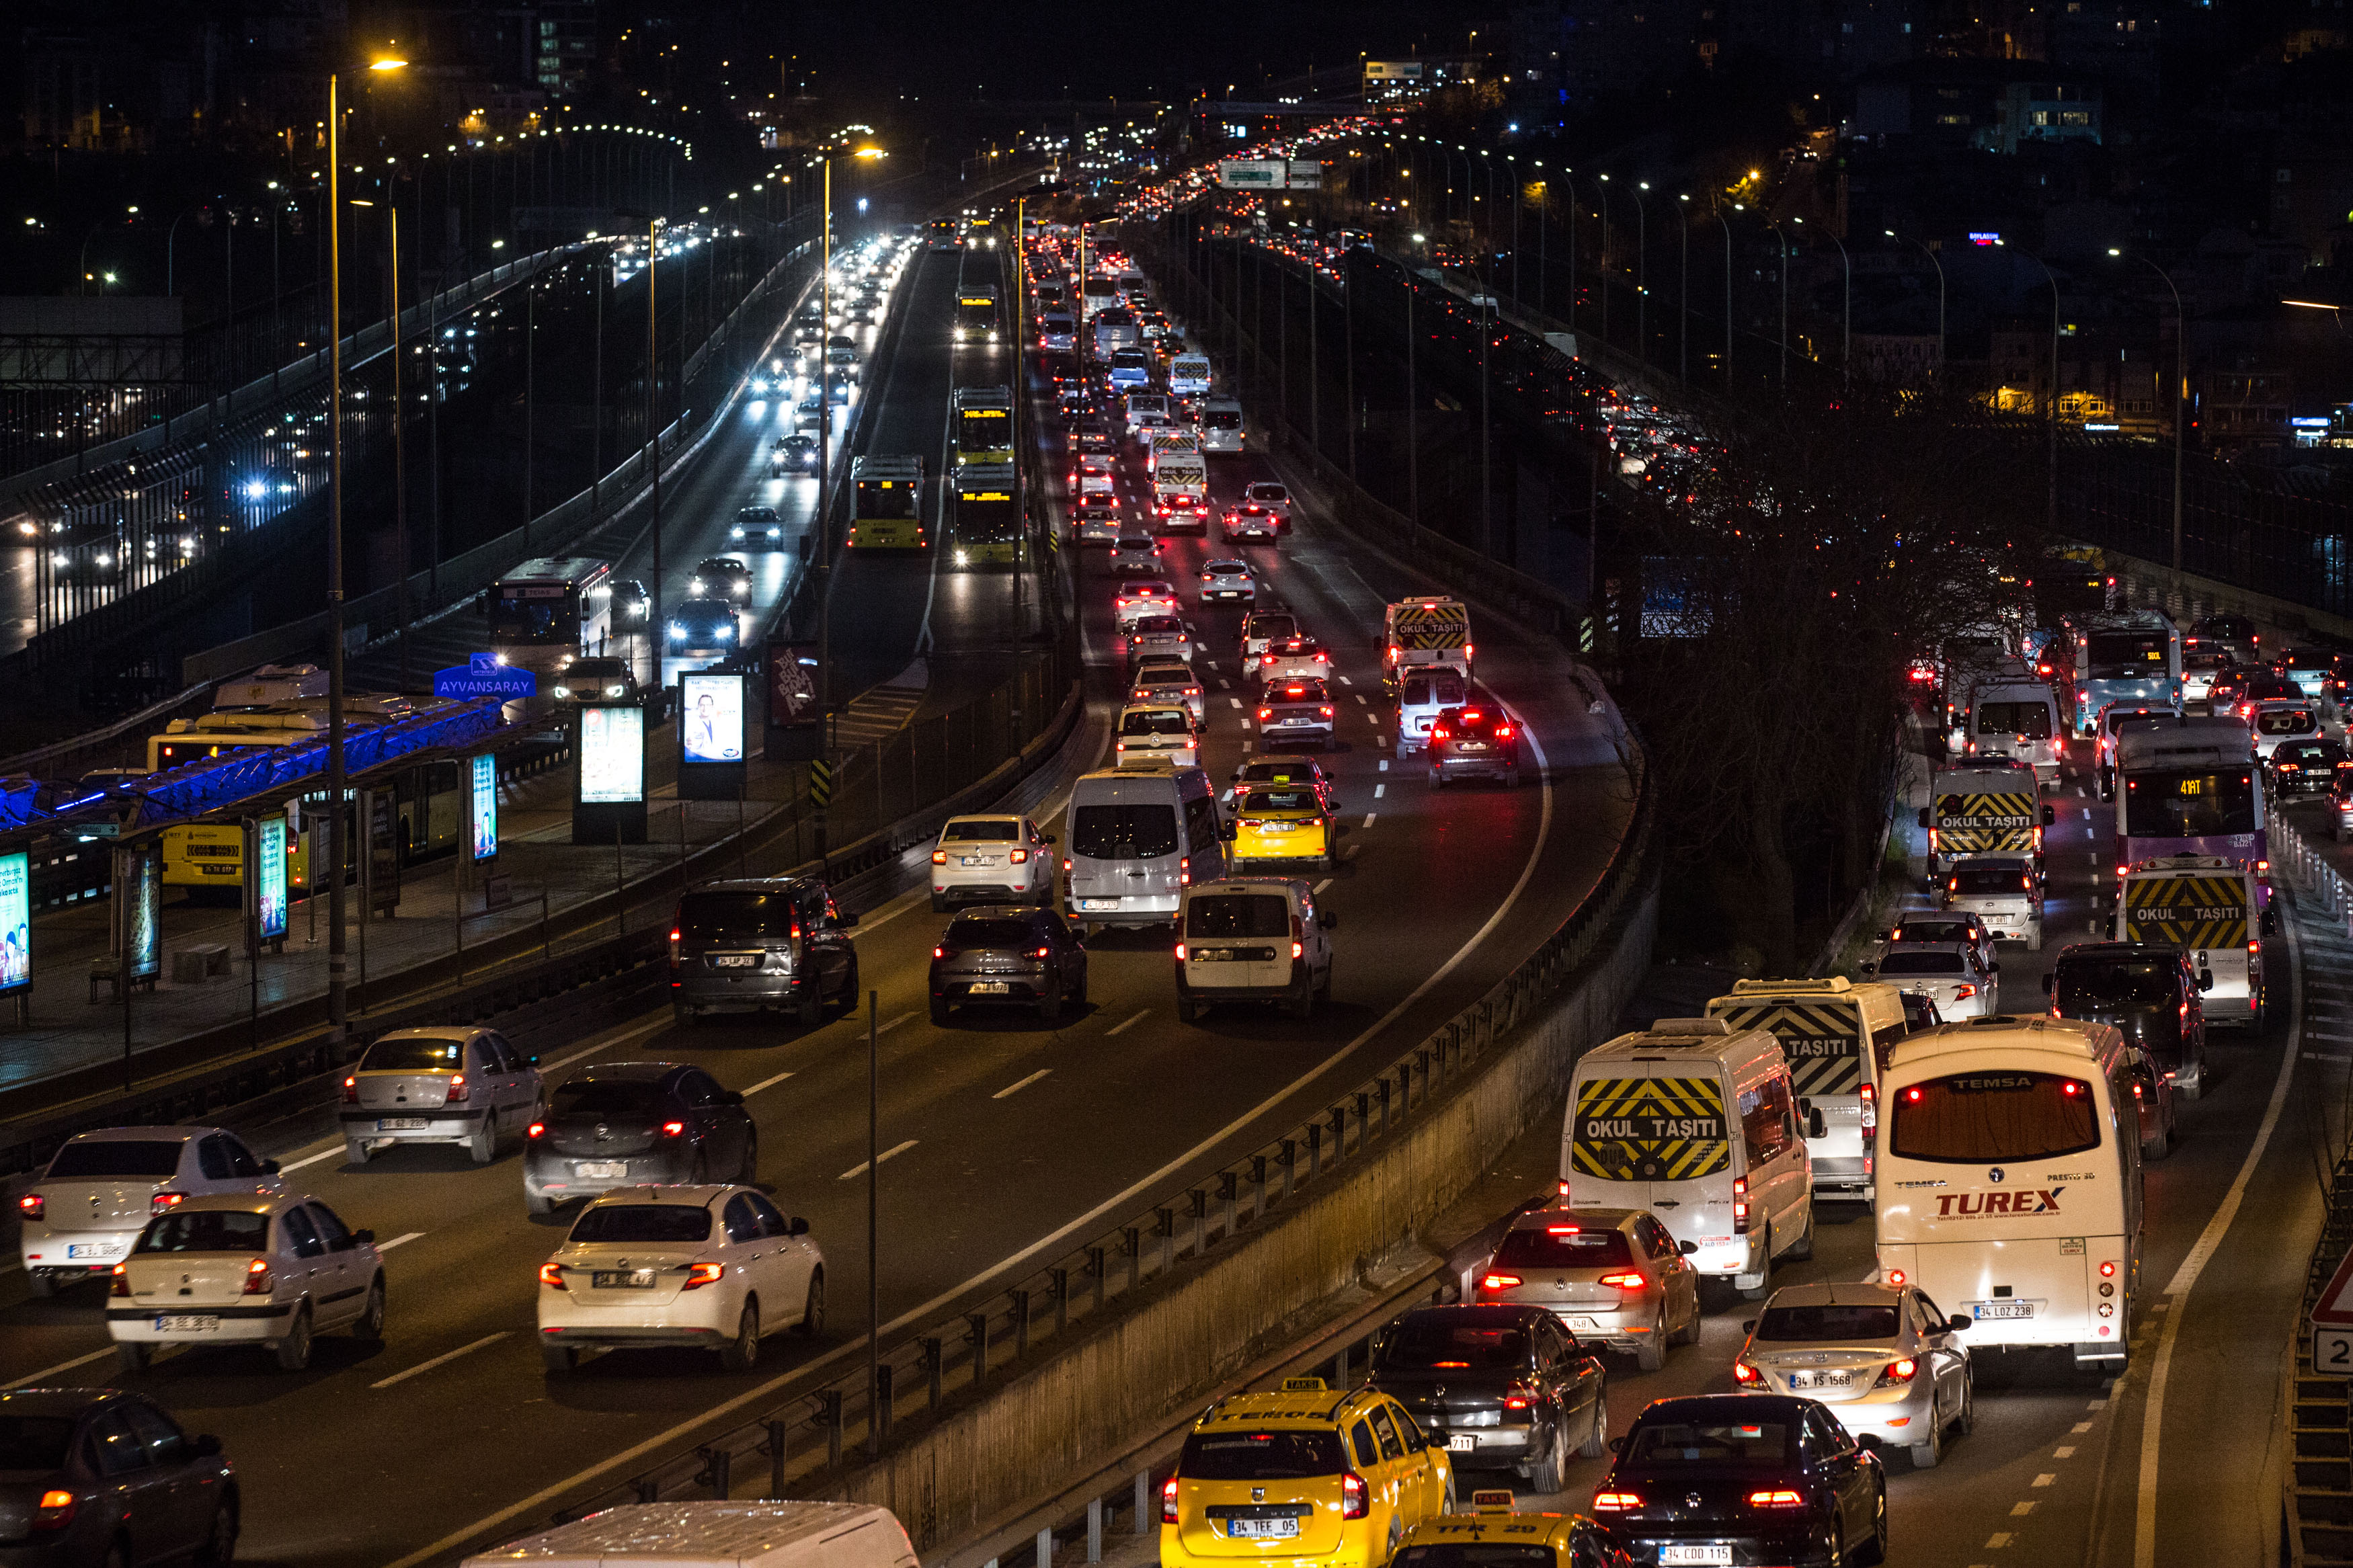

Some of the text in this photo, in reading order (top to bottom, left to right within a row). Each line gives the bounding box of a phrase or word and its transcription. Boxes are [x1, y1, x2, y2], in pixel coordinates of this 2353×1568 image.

[1400, 624, 1463, 634] OKUL TAŞITI
[440, 681, 530, 693] AYVANSARAY
[2180, 780, 2200, 794] 41AT
[1942, 815, 2030, 829] OKUL TAŞITI
[2137, 907, 2239, 922] OKUL TAŞITI
[742, 956, 754, 964] 321
[1788, 1039, 1846, 1057] TAŞITI
[1953, 1077, 2031, 1089] TEMSA
[1587, 1119, 1718, 1141] OKUL TAŞITI
[1894, 1180, 1948, 1188] TEMSA
[1936, 1186, 2066, 1215] TUREX
[1980, 1307, 2031, 1317] 34 LOZ 238
[1571, 1320, 1587, 1329] 348
[2330, 1339, 2350, 1364] 2
[1796, 1374, 1851, 1387] 34 YS 1568
[1235, 1519, 1295, 1533] 34 TEE 05
[1667, 1549, 1679, 1559] 34
[1710, 1548, 1728, 1559] 115
